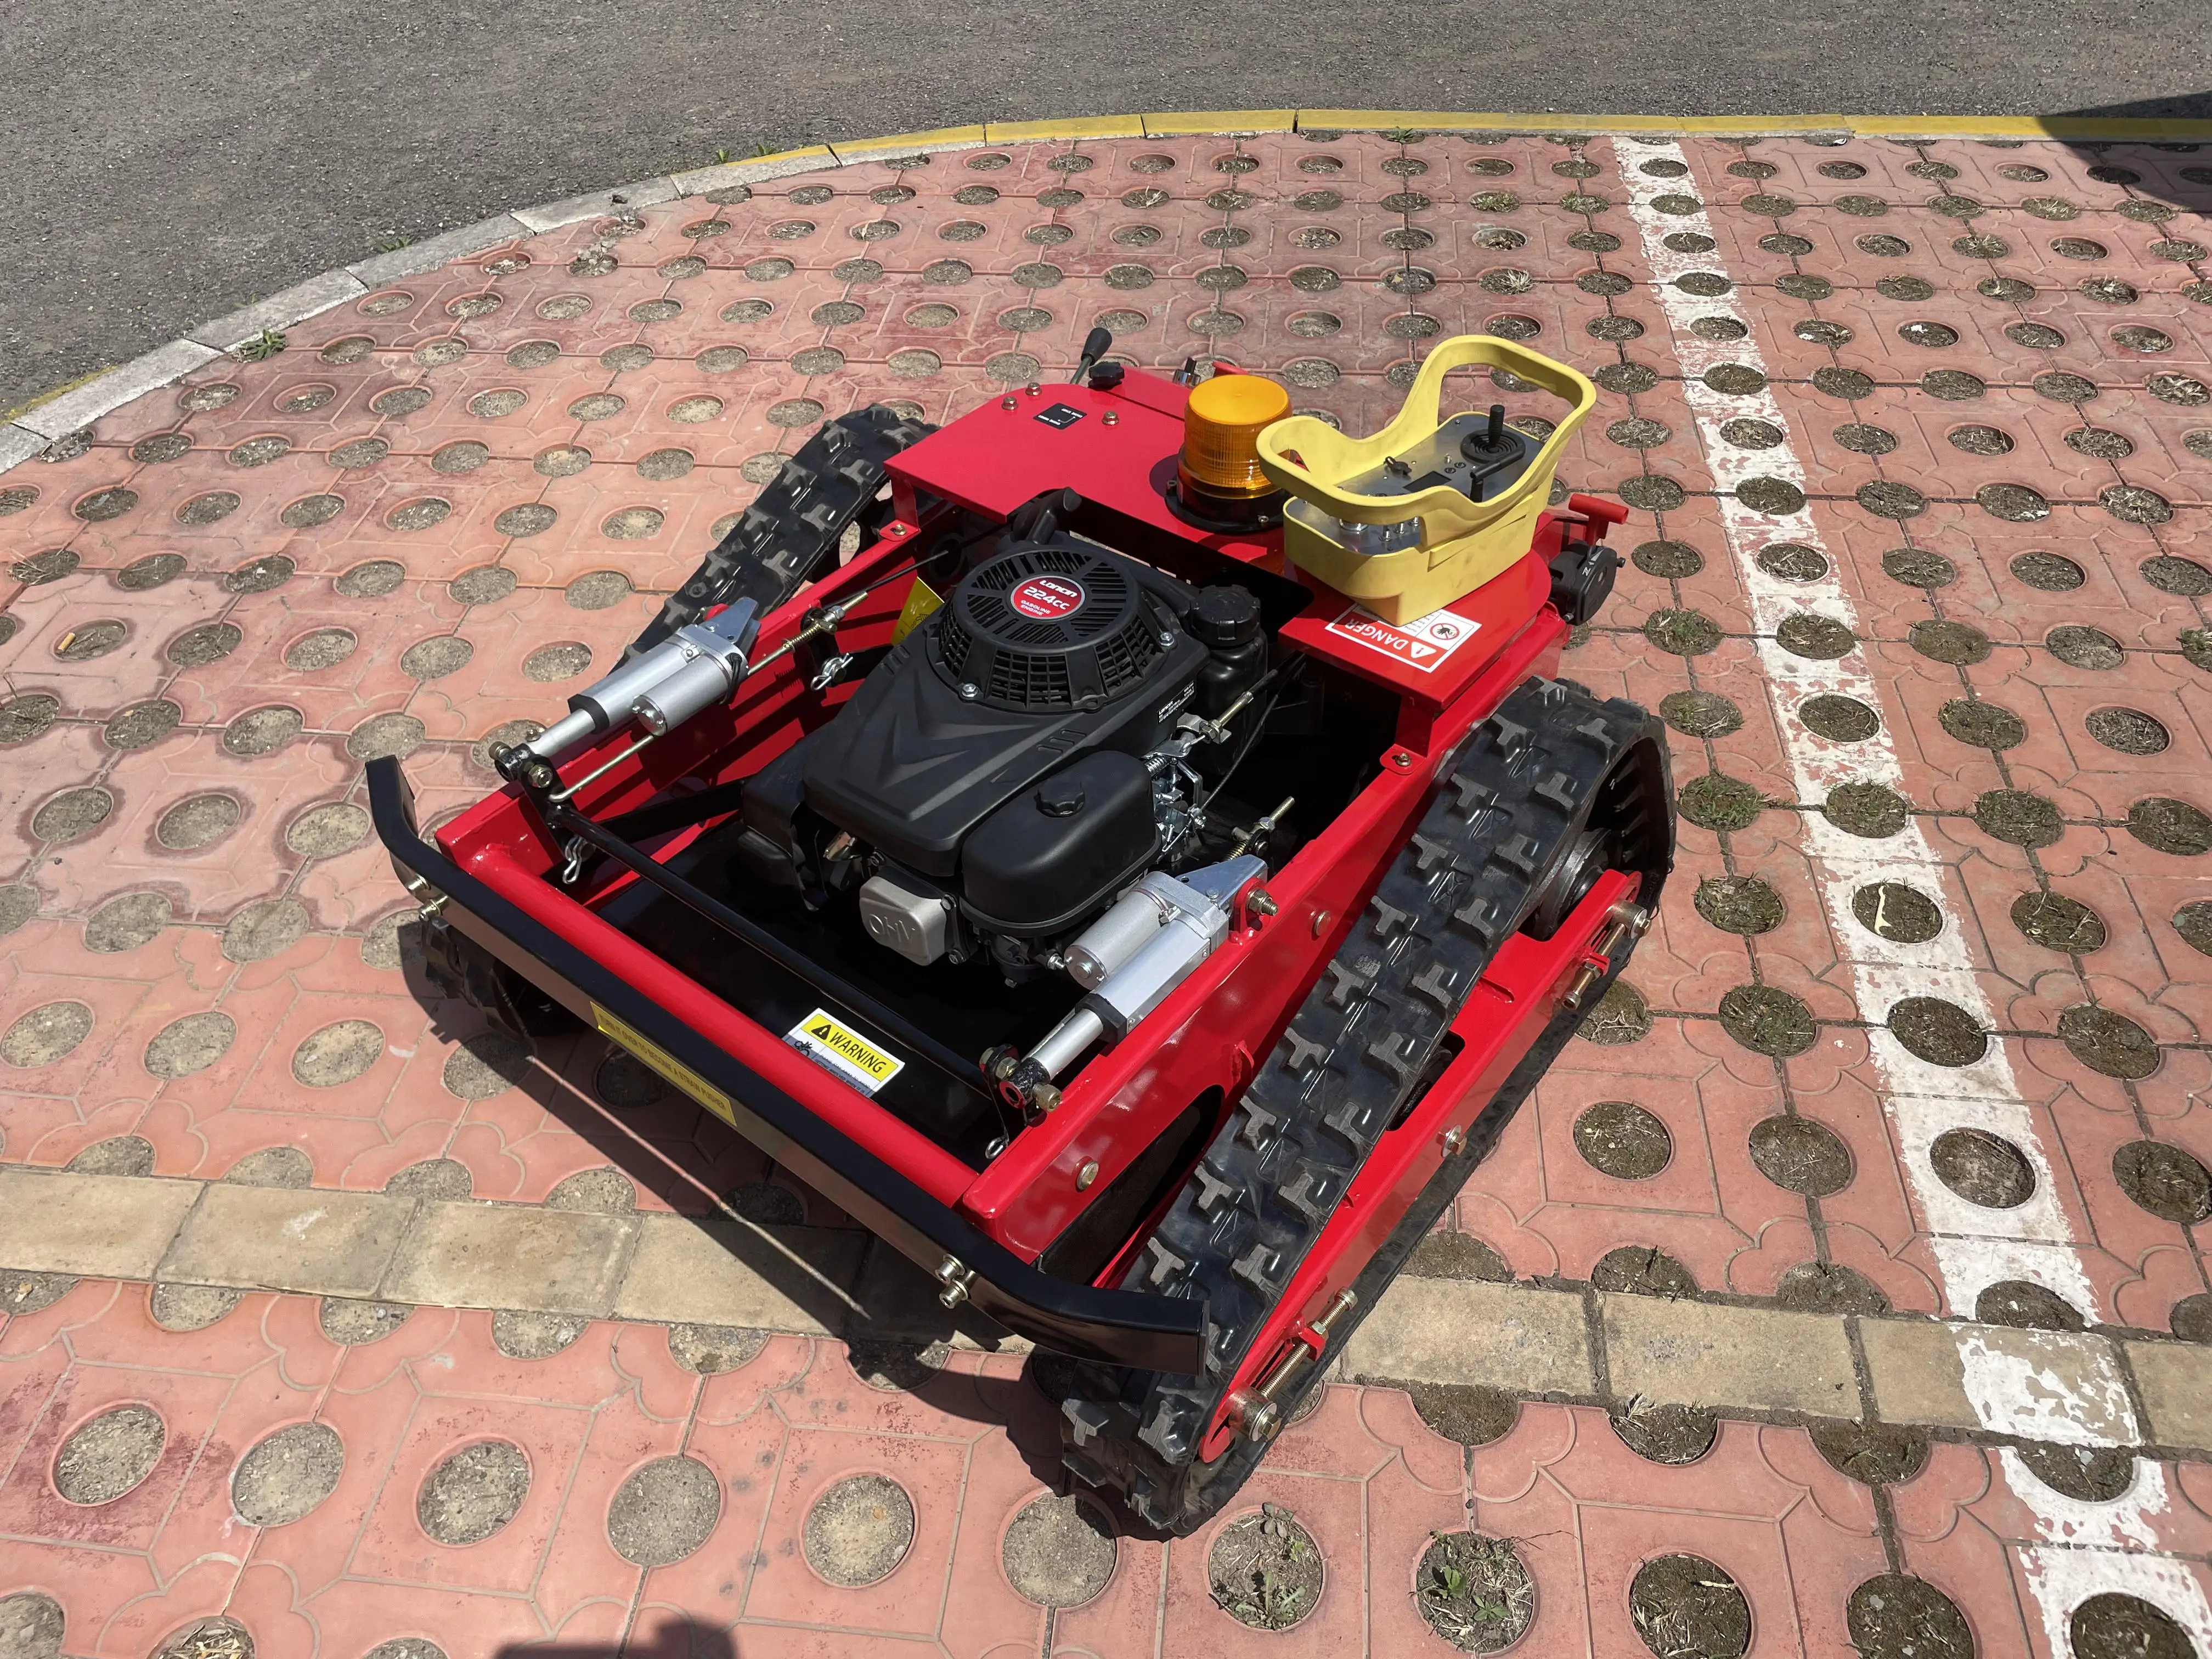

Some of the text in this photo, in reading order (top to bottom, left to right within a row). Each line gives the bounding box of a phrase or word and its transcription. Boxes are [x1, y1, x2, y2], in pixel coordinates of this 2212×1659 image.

[1020, 604, 1044, 616] ENGINE
[1021, 600, 1051, 614] GASOLINE
[1345, 618, 1409, 650] DANGER
[869, 913, 916, 943] OHV
[622, 1031, 639, 1047] OVER
[638, 1042, 647, 1053] TO
[830, 1031, 887, 1073] WARNING
